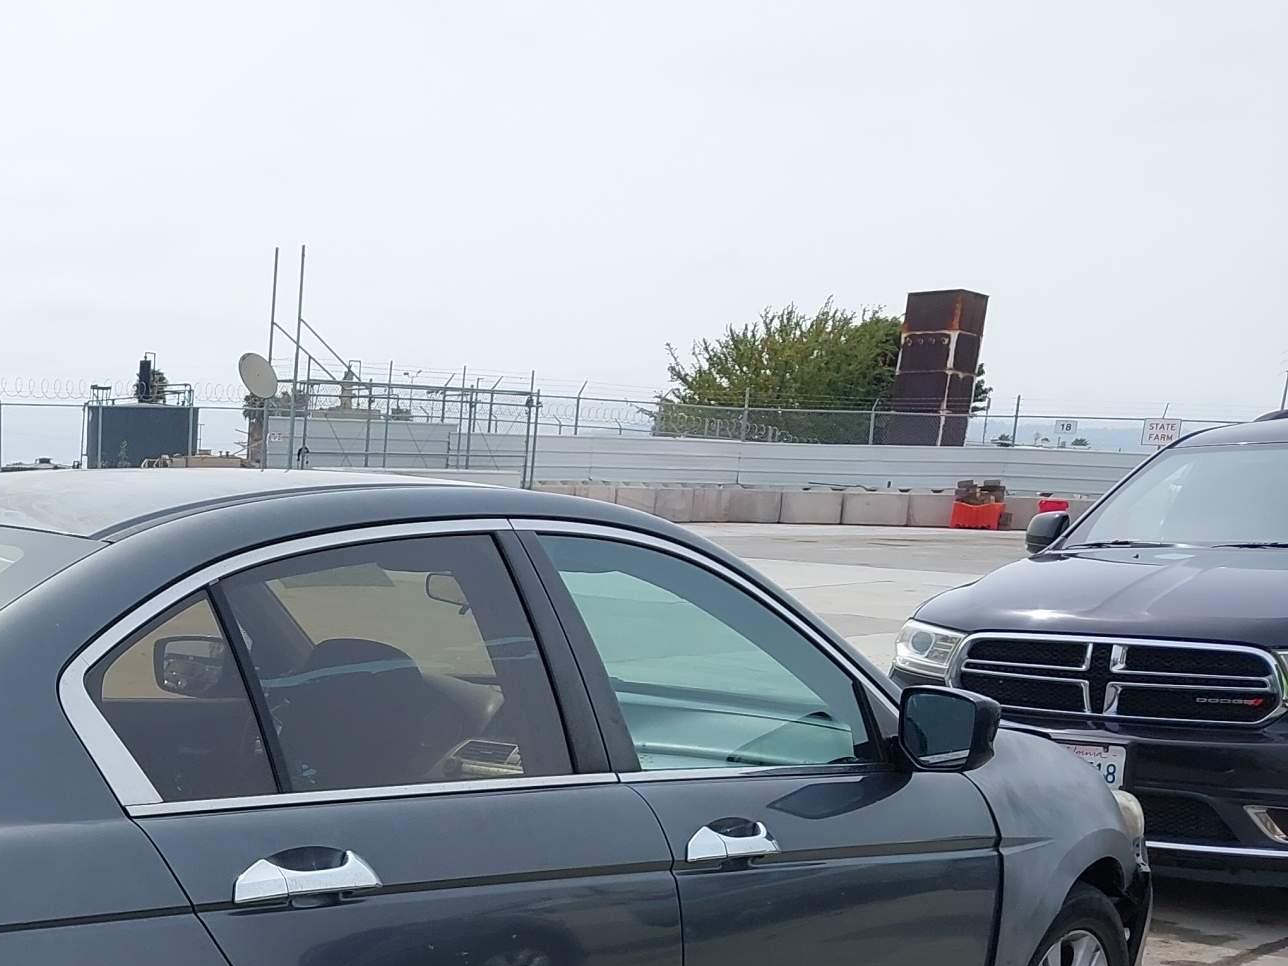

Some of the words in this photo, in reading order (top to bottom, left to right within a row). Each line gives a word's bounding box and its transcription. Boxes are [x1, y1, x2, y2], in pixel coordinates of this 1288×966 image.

[1060, 423, 1072, 432] 18
[1149, 422, 1177, 431] STATE
[1148, 433, 1174, 441] FARM
[1196, 697, 1253, 705] DODGE
